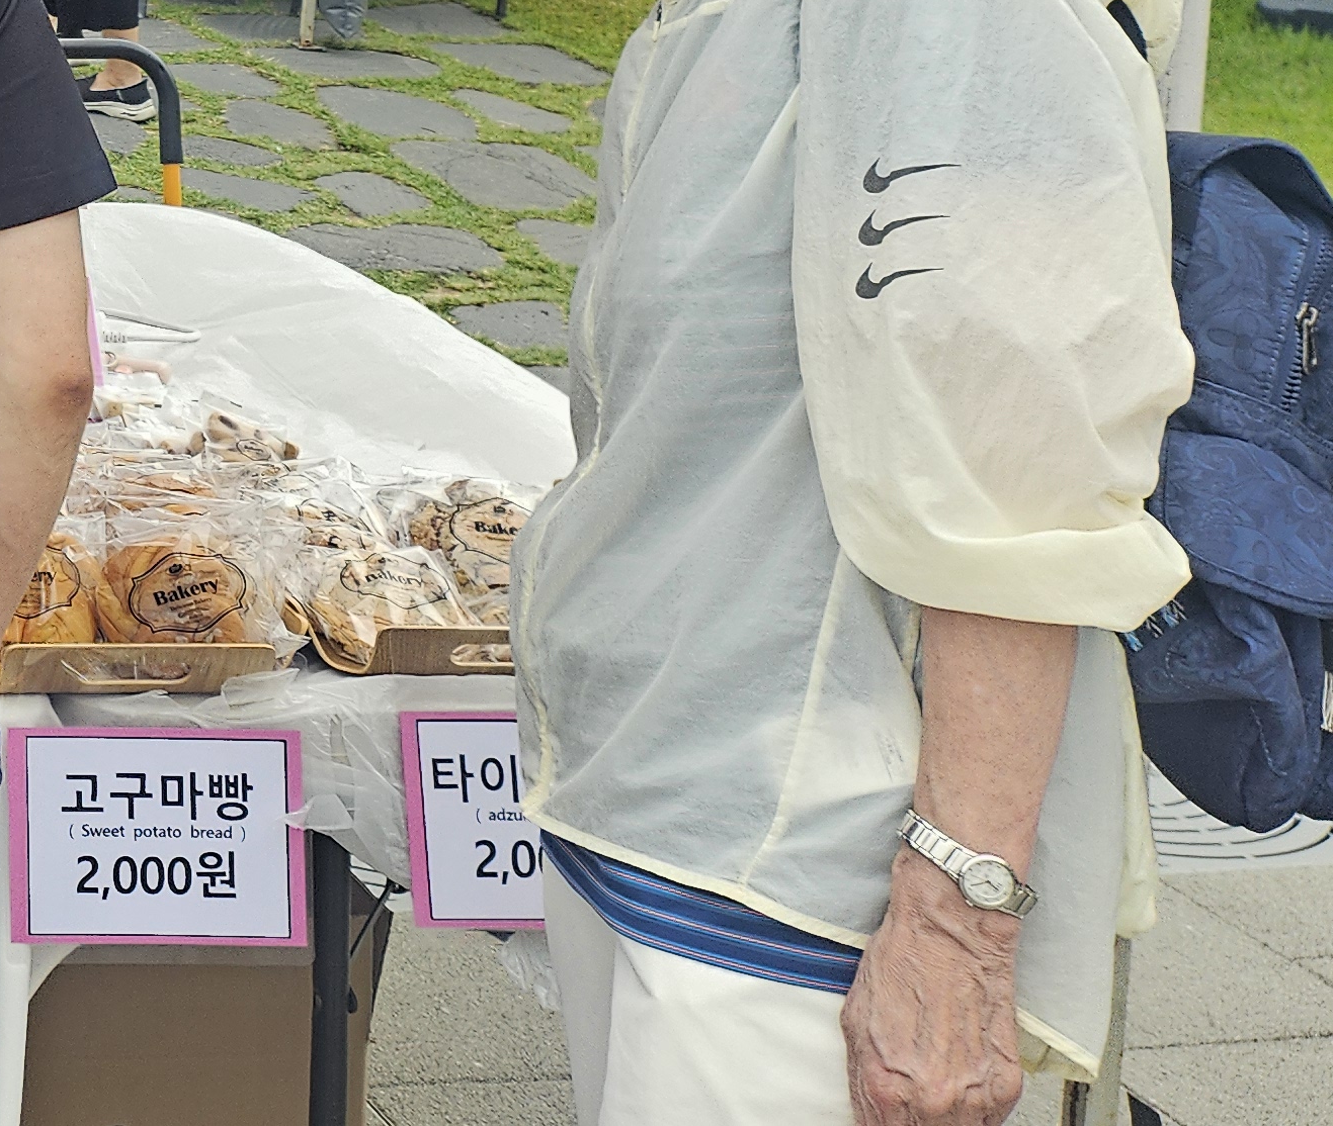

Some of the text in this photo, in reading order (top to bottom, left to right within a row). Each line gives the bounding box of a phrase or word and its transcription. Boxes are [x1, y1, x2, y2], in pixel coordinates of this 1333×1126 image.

[152, 578, 219, 607] Bakery
[61, 771, 254, 821] 고구마빵
[431, 754, 520, 804] 타이
[81, 824, 126, 838] Sweet
[133, 826, 182, 841] potato
[190, 824, 233, 839] bread
[488, 807, 528, 822] adzu
[76, 850, 237, 900] 2,000원
